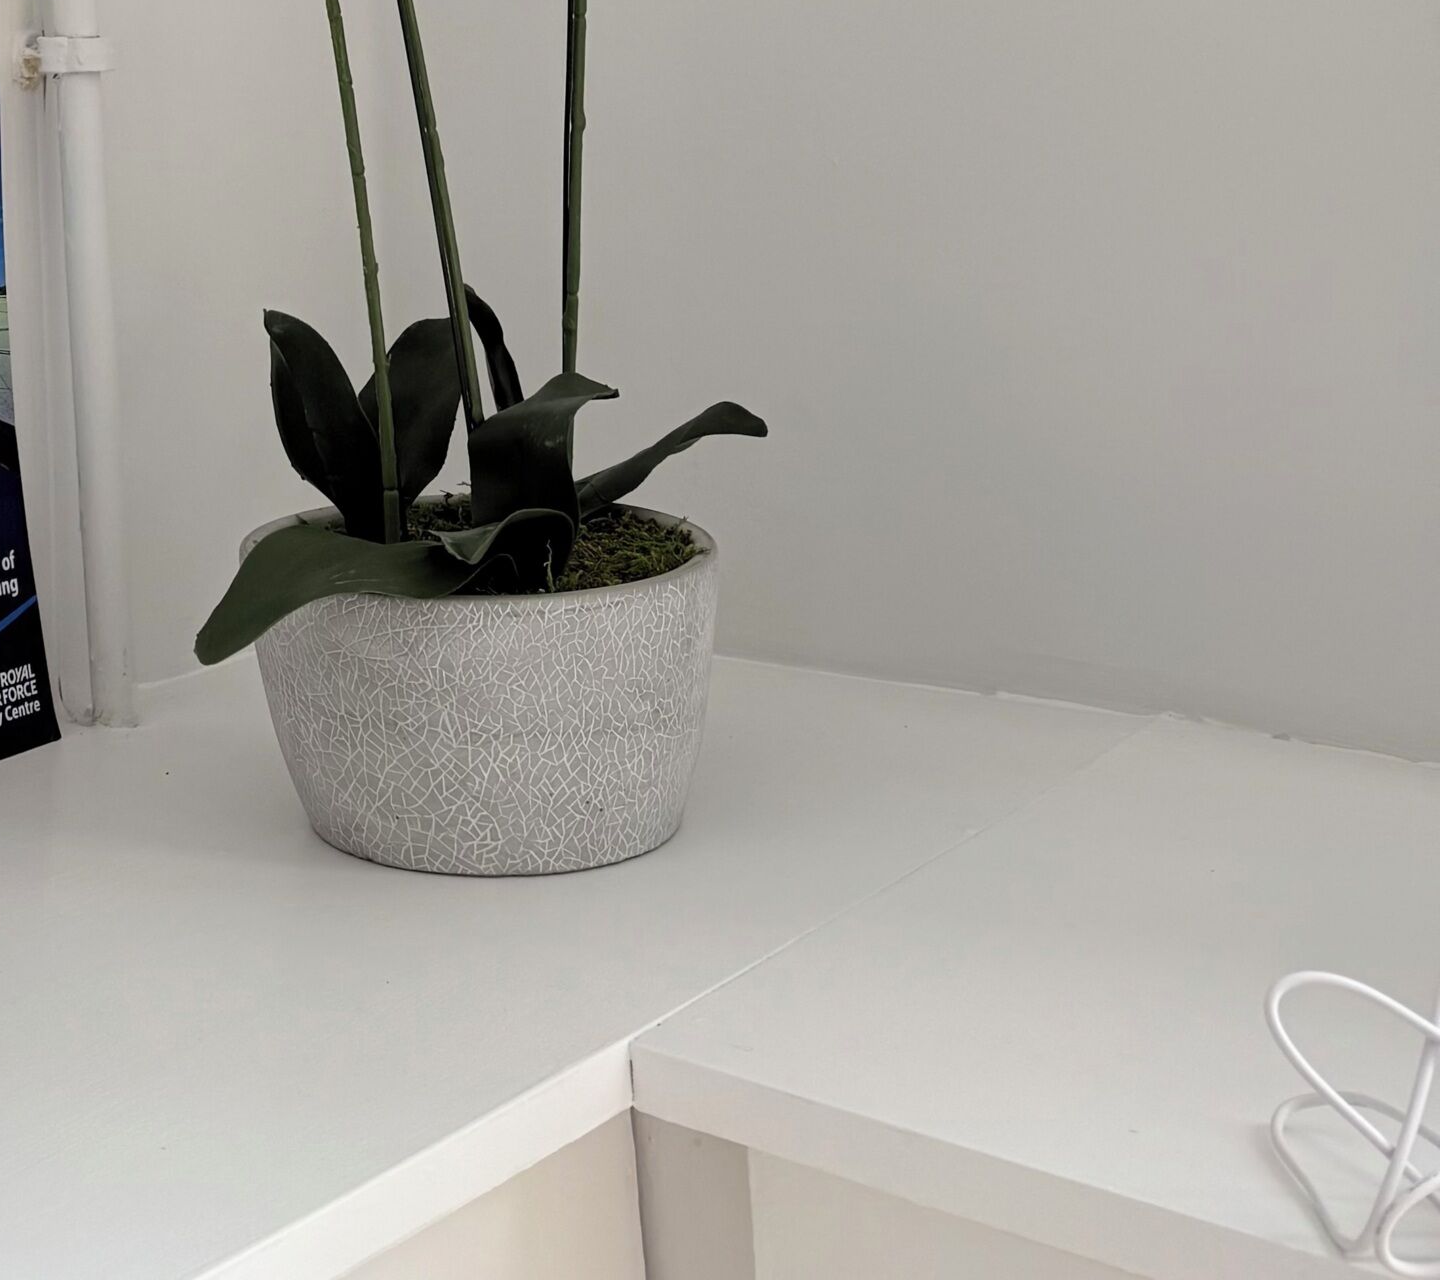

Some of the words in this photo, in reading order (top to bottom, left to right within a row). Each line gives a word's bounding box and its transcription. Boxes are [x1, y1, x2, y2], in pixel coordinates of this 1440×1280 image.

[2, 549, 15, 571] of
[0, 663, 36, 688] ROYAL
[2, 680, 38, 704] FORCE
[5, 700, 41, 721] Centre
